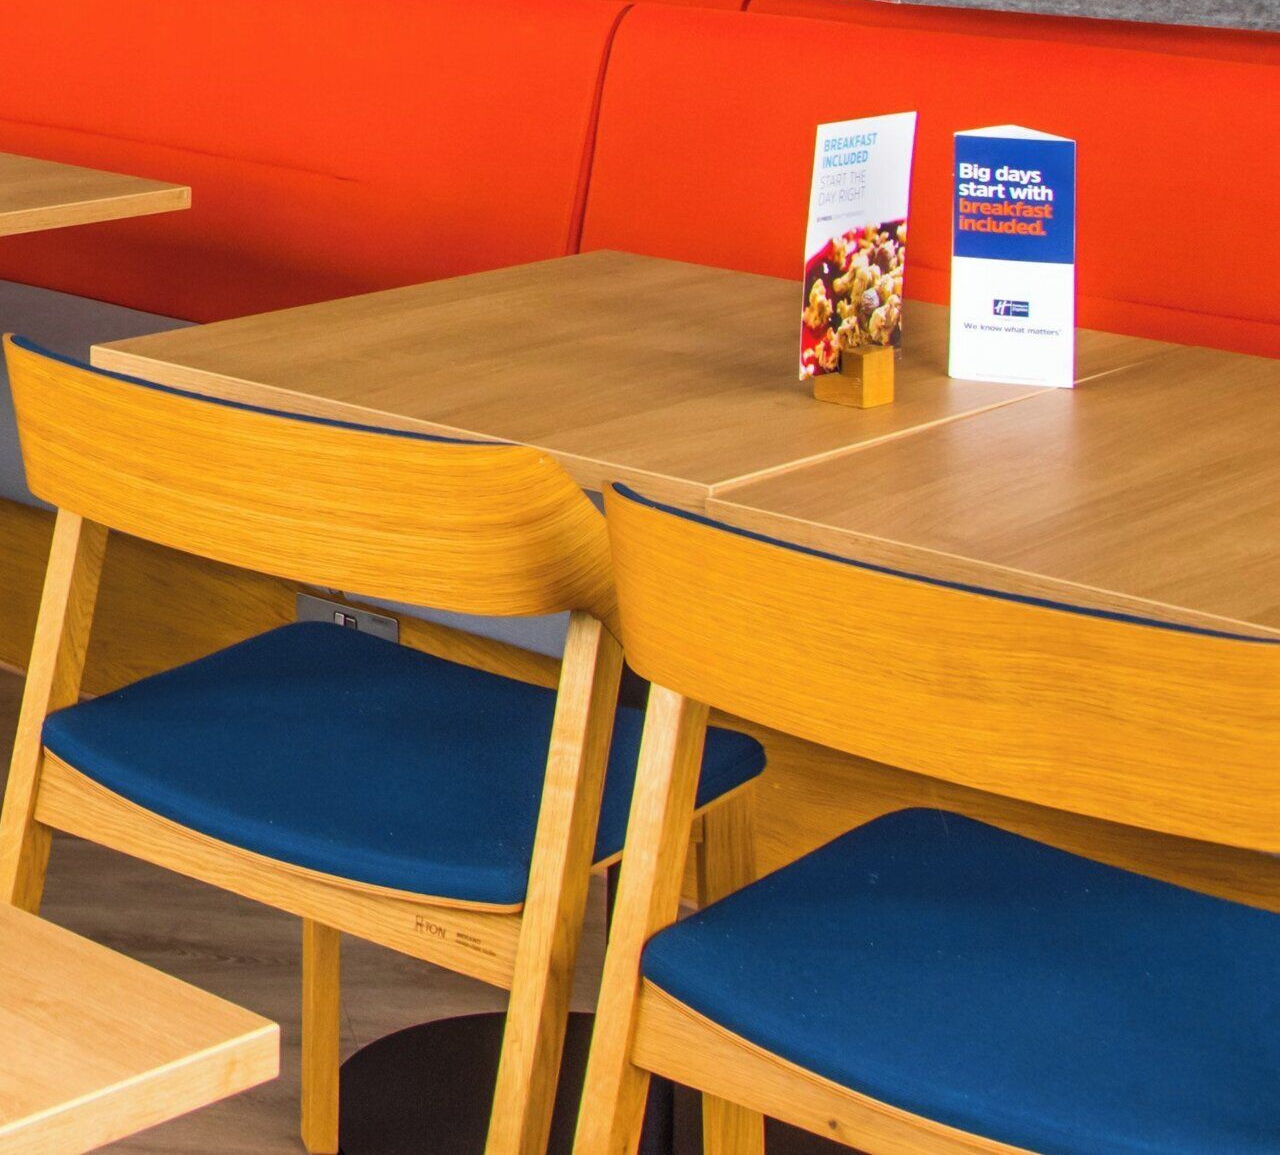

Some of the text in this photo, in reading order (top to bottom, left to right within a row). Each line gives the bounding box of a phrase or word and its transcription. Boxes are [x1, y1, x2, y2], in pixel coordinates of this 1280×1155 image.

[824, 132, 878, 152] BREAKFAST
[822, 150, 869, 169] INCLUDED
[819, 169, 867, 190] START THE
[959, 162, 1042, 184] Big days
[817, 185, 867, 207] DAY RIGHT
[958, 182, 1054, 202] start with
[959, 198, 1053, 219] breakfast
[959, 217, 1047, 236] included.
[963, 322, 1060, 336] We know what matters
